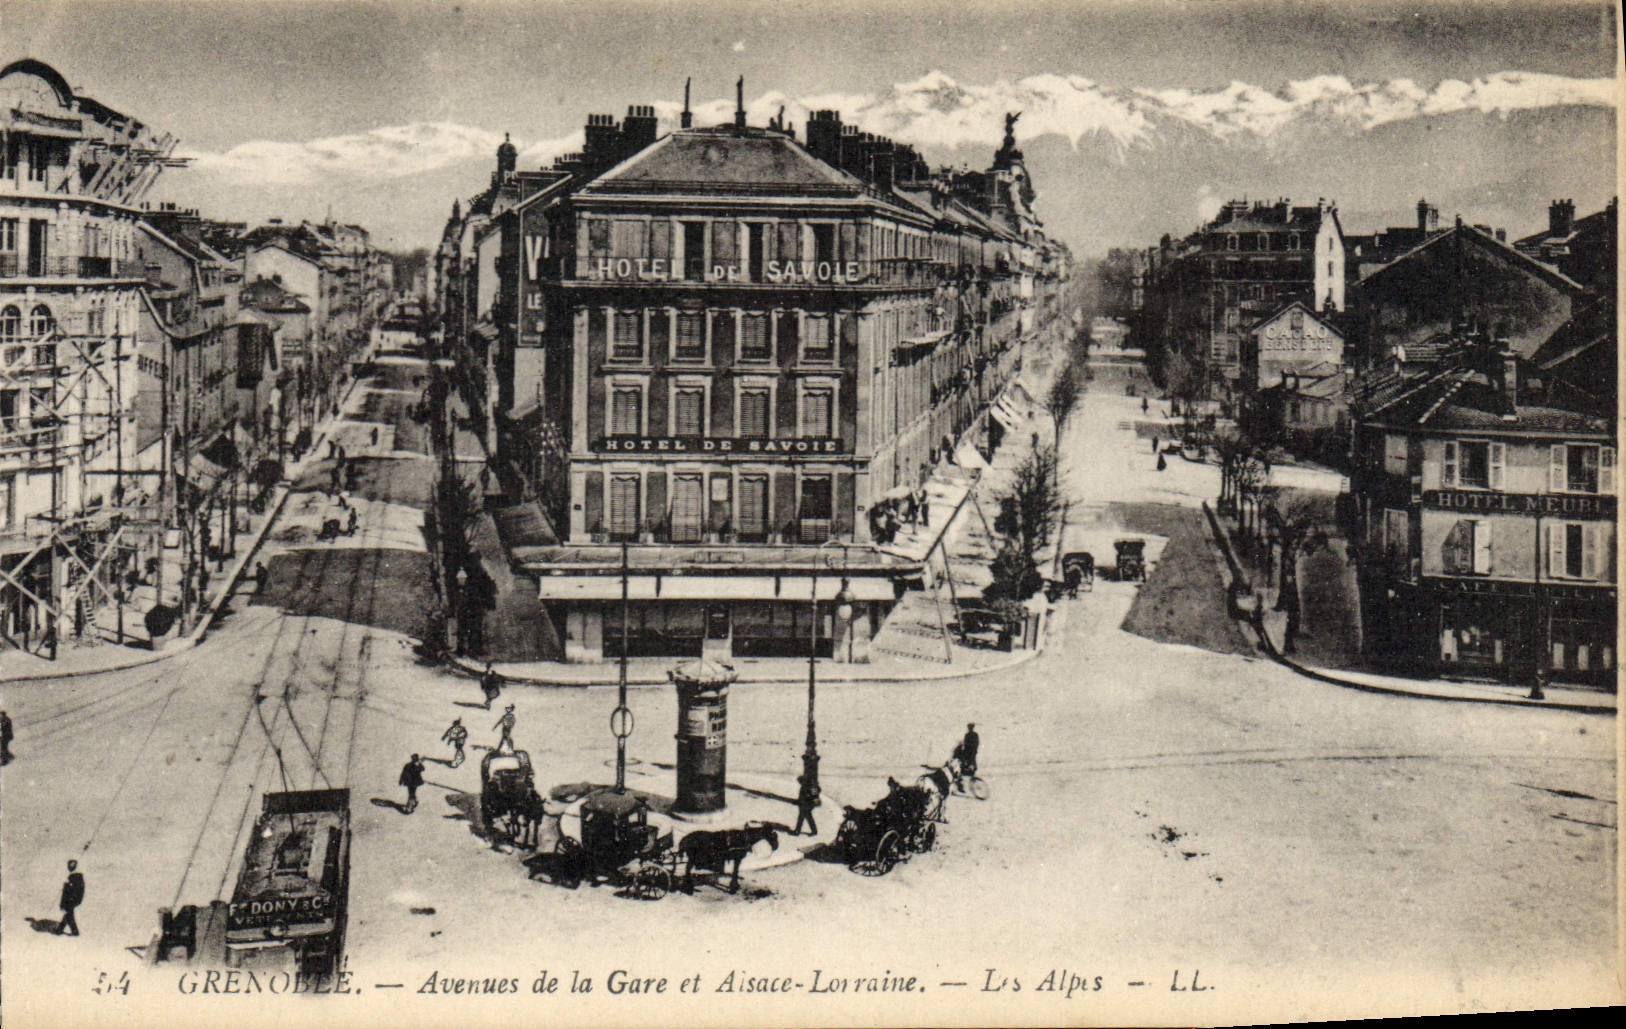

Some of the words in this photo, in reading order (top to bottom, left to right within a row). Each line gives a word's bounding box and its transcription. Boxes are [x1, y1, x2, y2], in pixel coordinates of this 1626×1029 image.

[597, 258, 685, 281] HOTEL
[714, 264, 738, 281] DE
[767, 259, 860, 283] SAVOIE
[1265, 325, 1329, 340] CACAO
[606, 439, 687, 452] HOTEL
[703, 440, 733, 452] DE
[748, 440, 838, 452] SAVOIE
[1437, 492, 1516, 511] HOTEL
[251, 898, 300, 915] DONY
